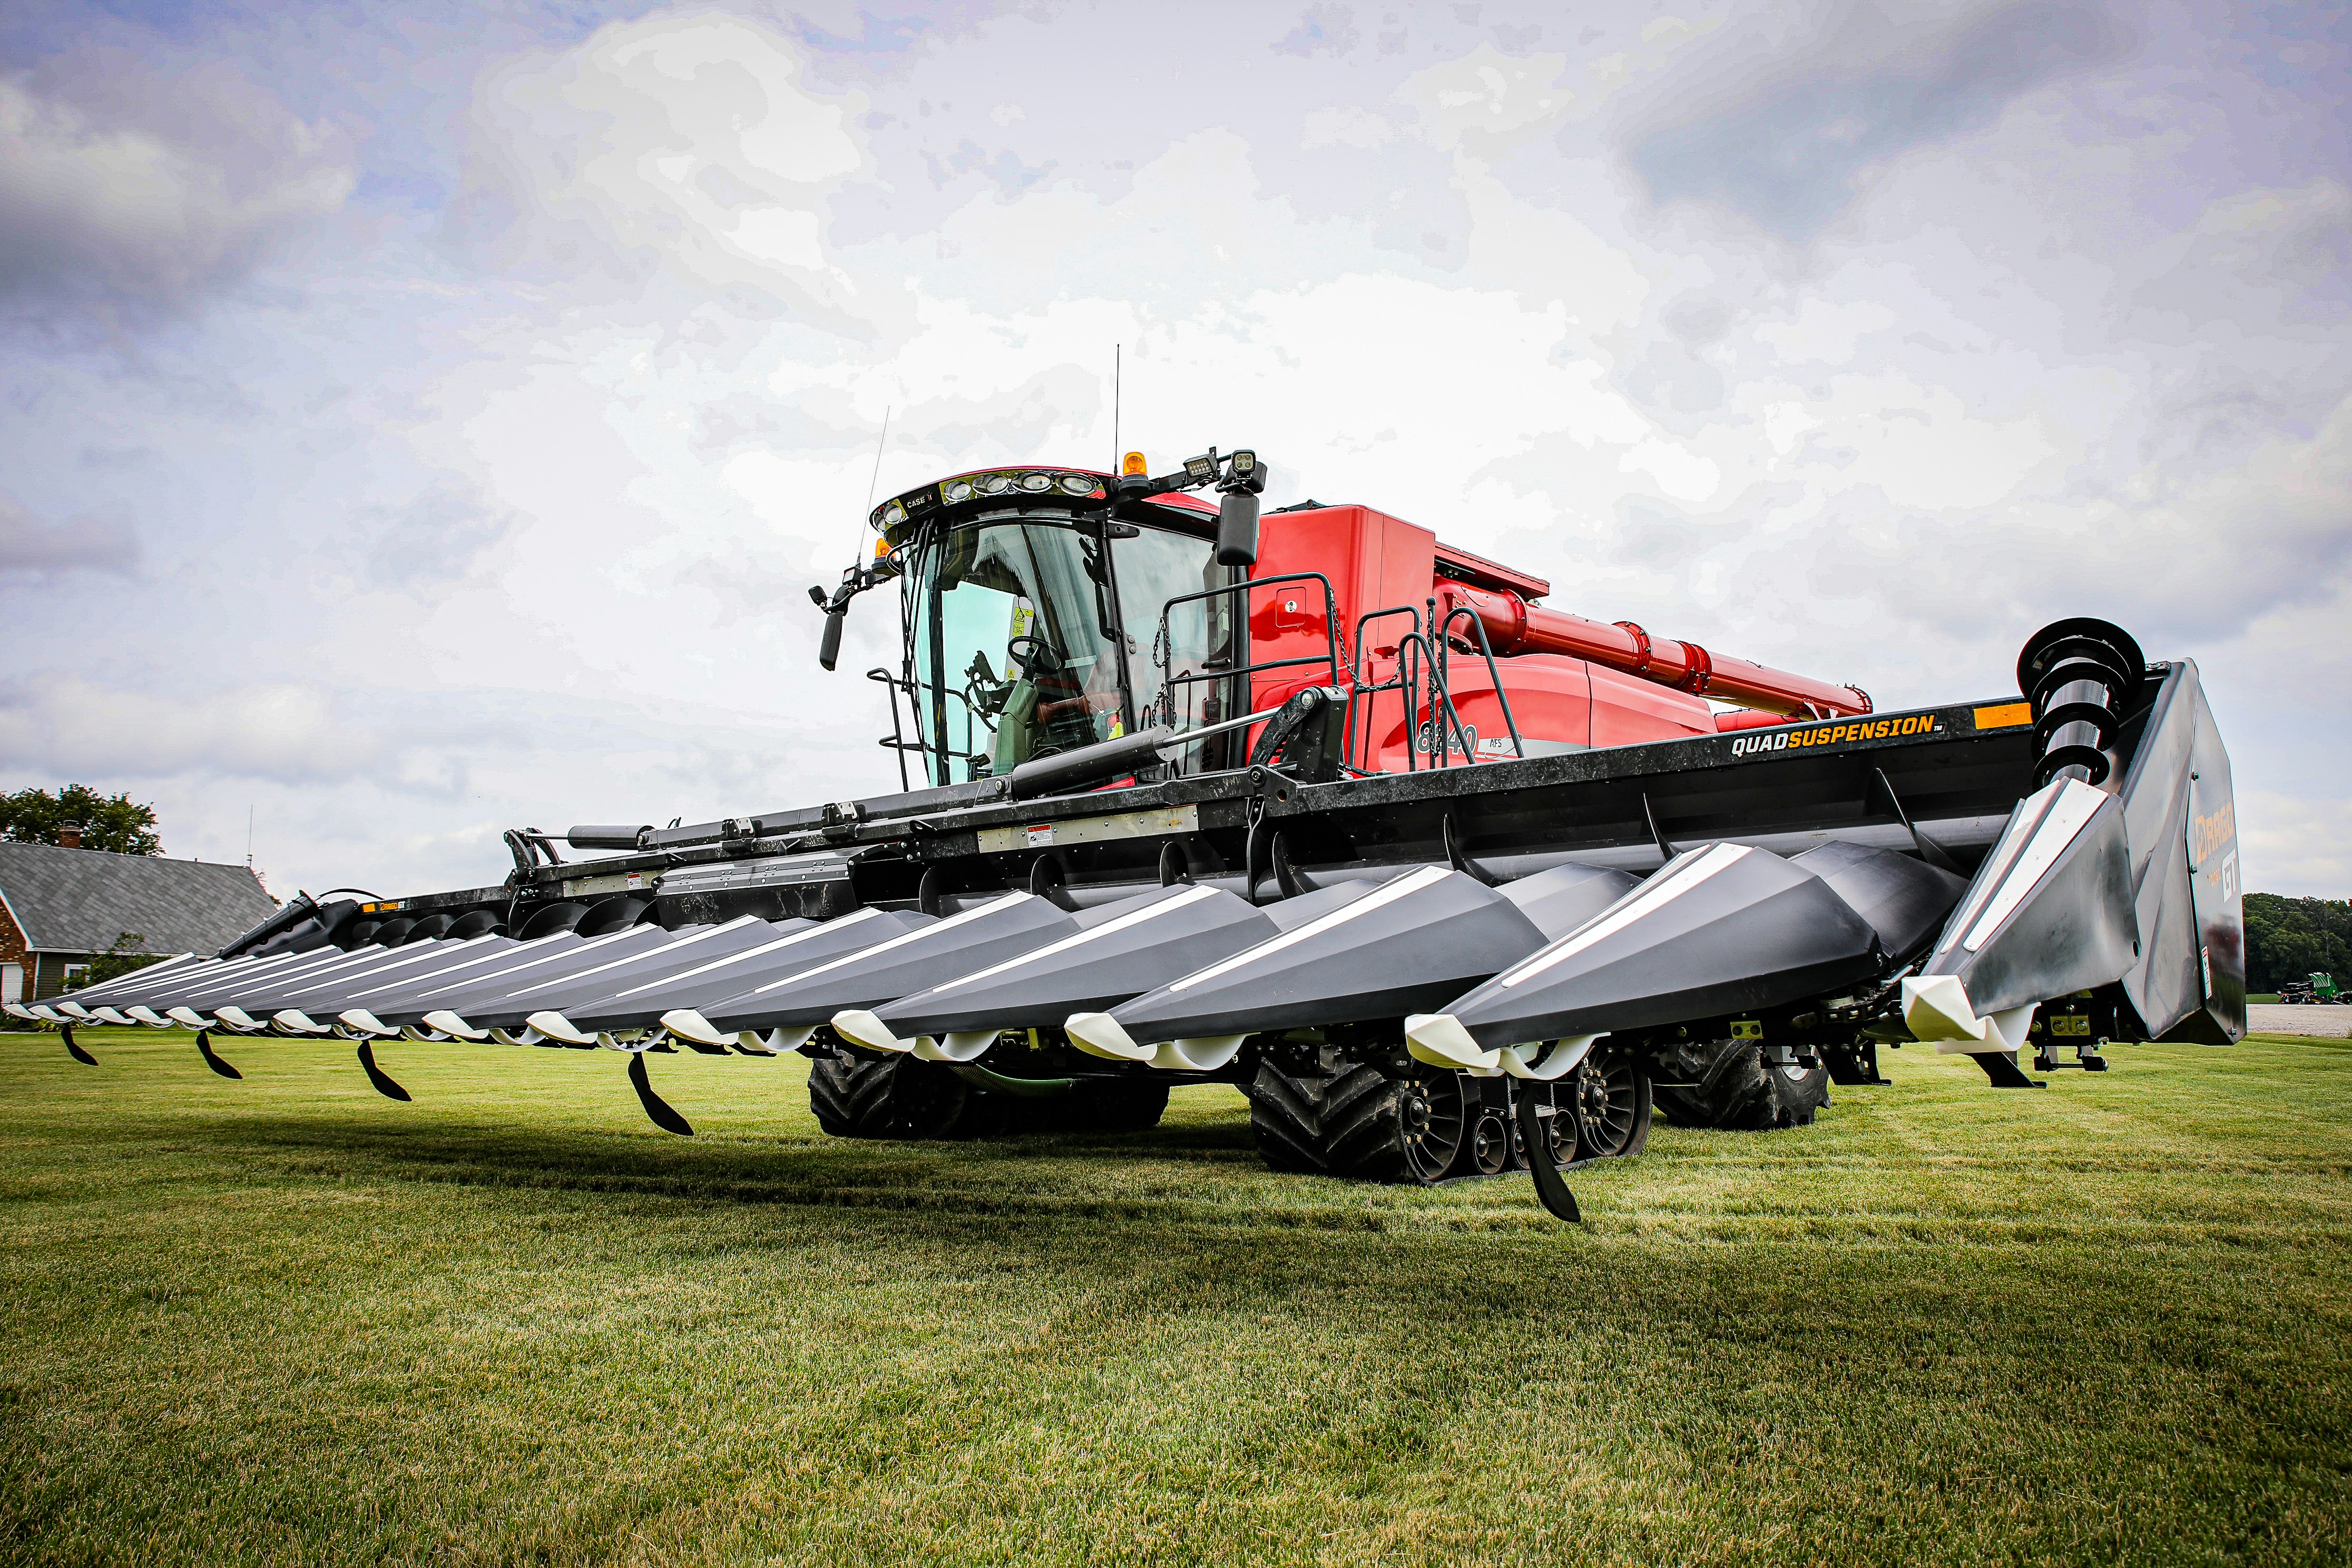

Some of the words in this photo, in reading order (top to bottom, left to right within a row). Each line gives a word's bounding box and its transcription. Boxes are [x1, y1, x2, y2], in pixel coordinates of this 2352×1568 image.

[907, 497, 925, 508] CASE
[1416, 721, 1477, 756] 840
[1489, 739, 1502, 748] AFS
[1731, 715, 1935, 757] QUADSUSPENSION
[2195, 802, 2235, 865] DRAGO
[2221, 848, 2236, 903] GT
